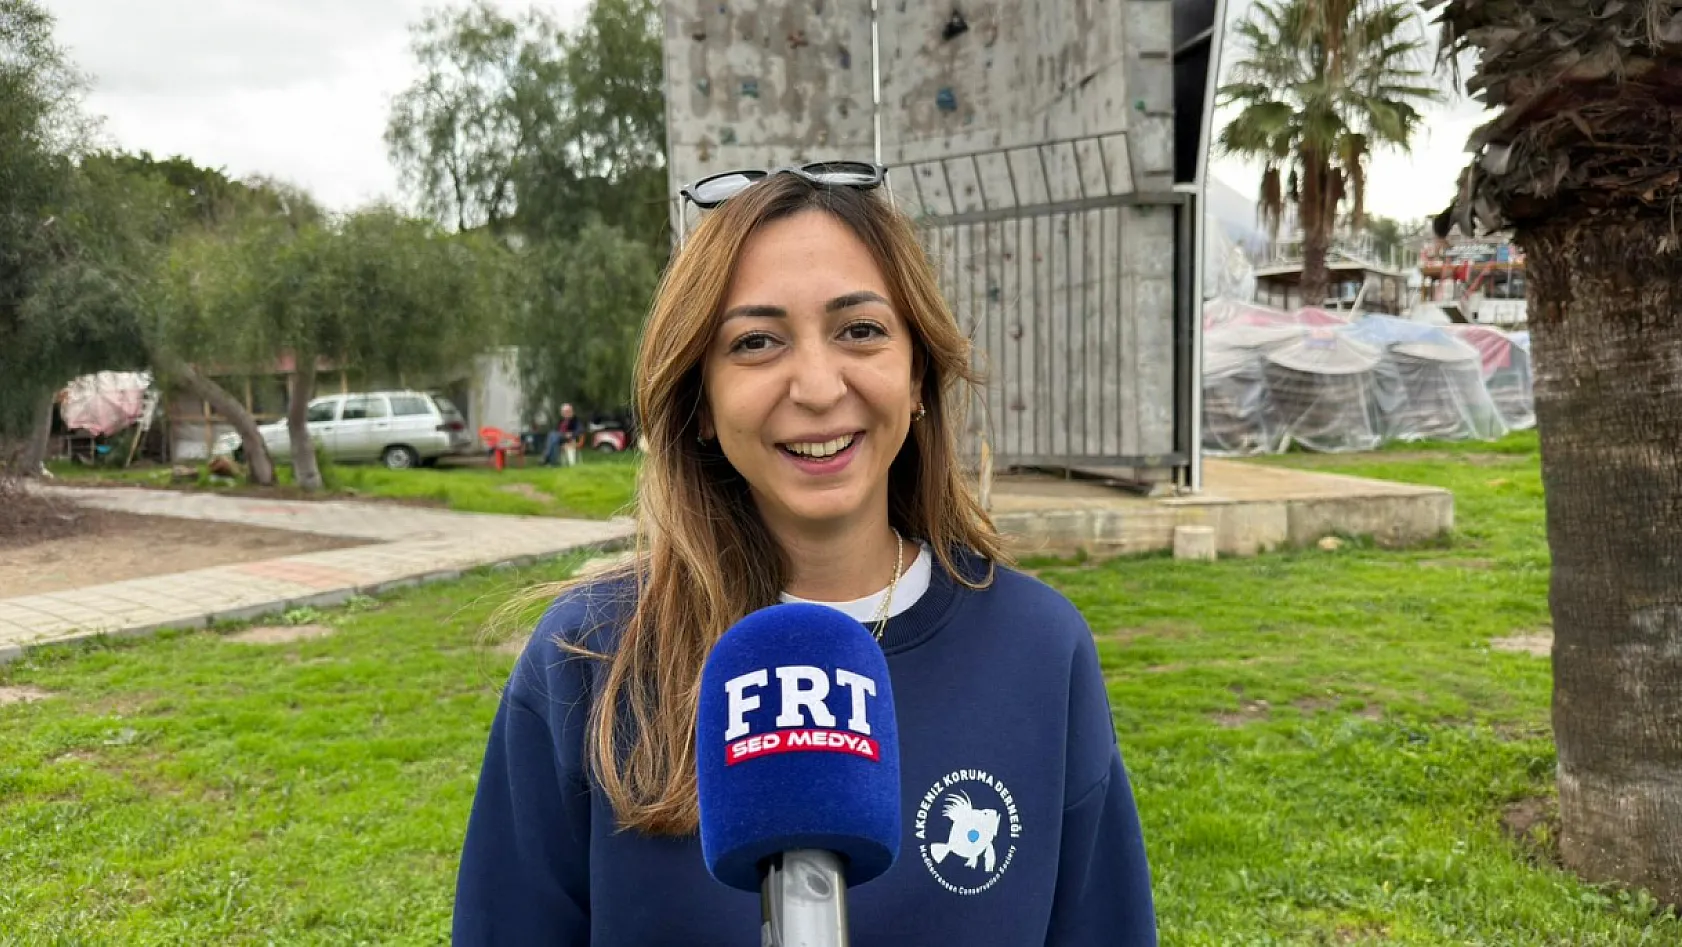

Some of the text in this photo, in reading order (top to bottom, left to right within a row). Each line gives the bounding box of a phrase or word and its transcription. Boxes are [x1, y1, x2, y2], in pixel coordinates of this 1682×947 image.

[725, 666, 877, 741] FRT
[732, 731, 873, 758] SED MEDYA
[943, 769, 994, 787] KORUMA
